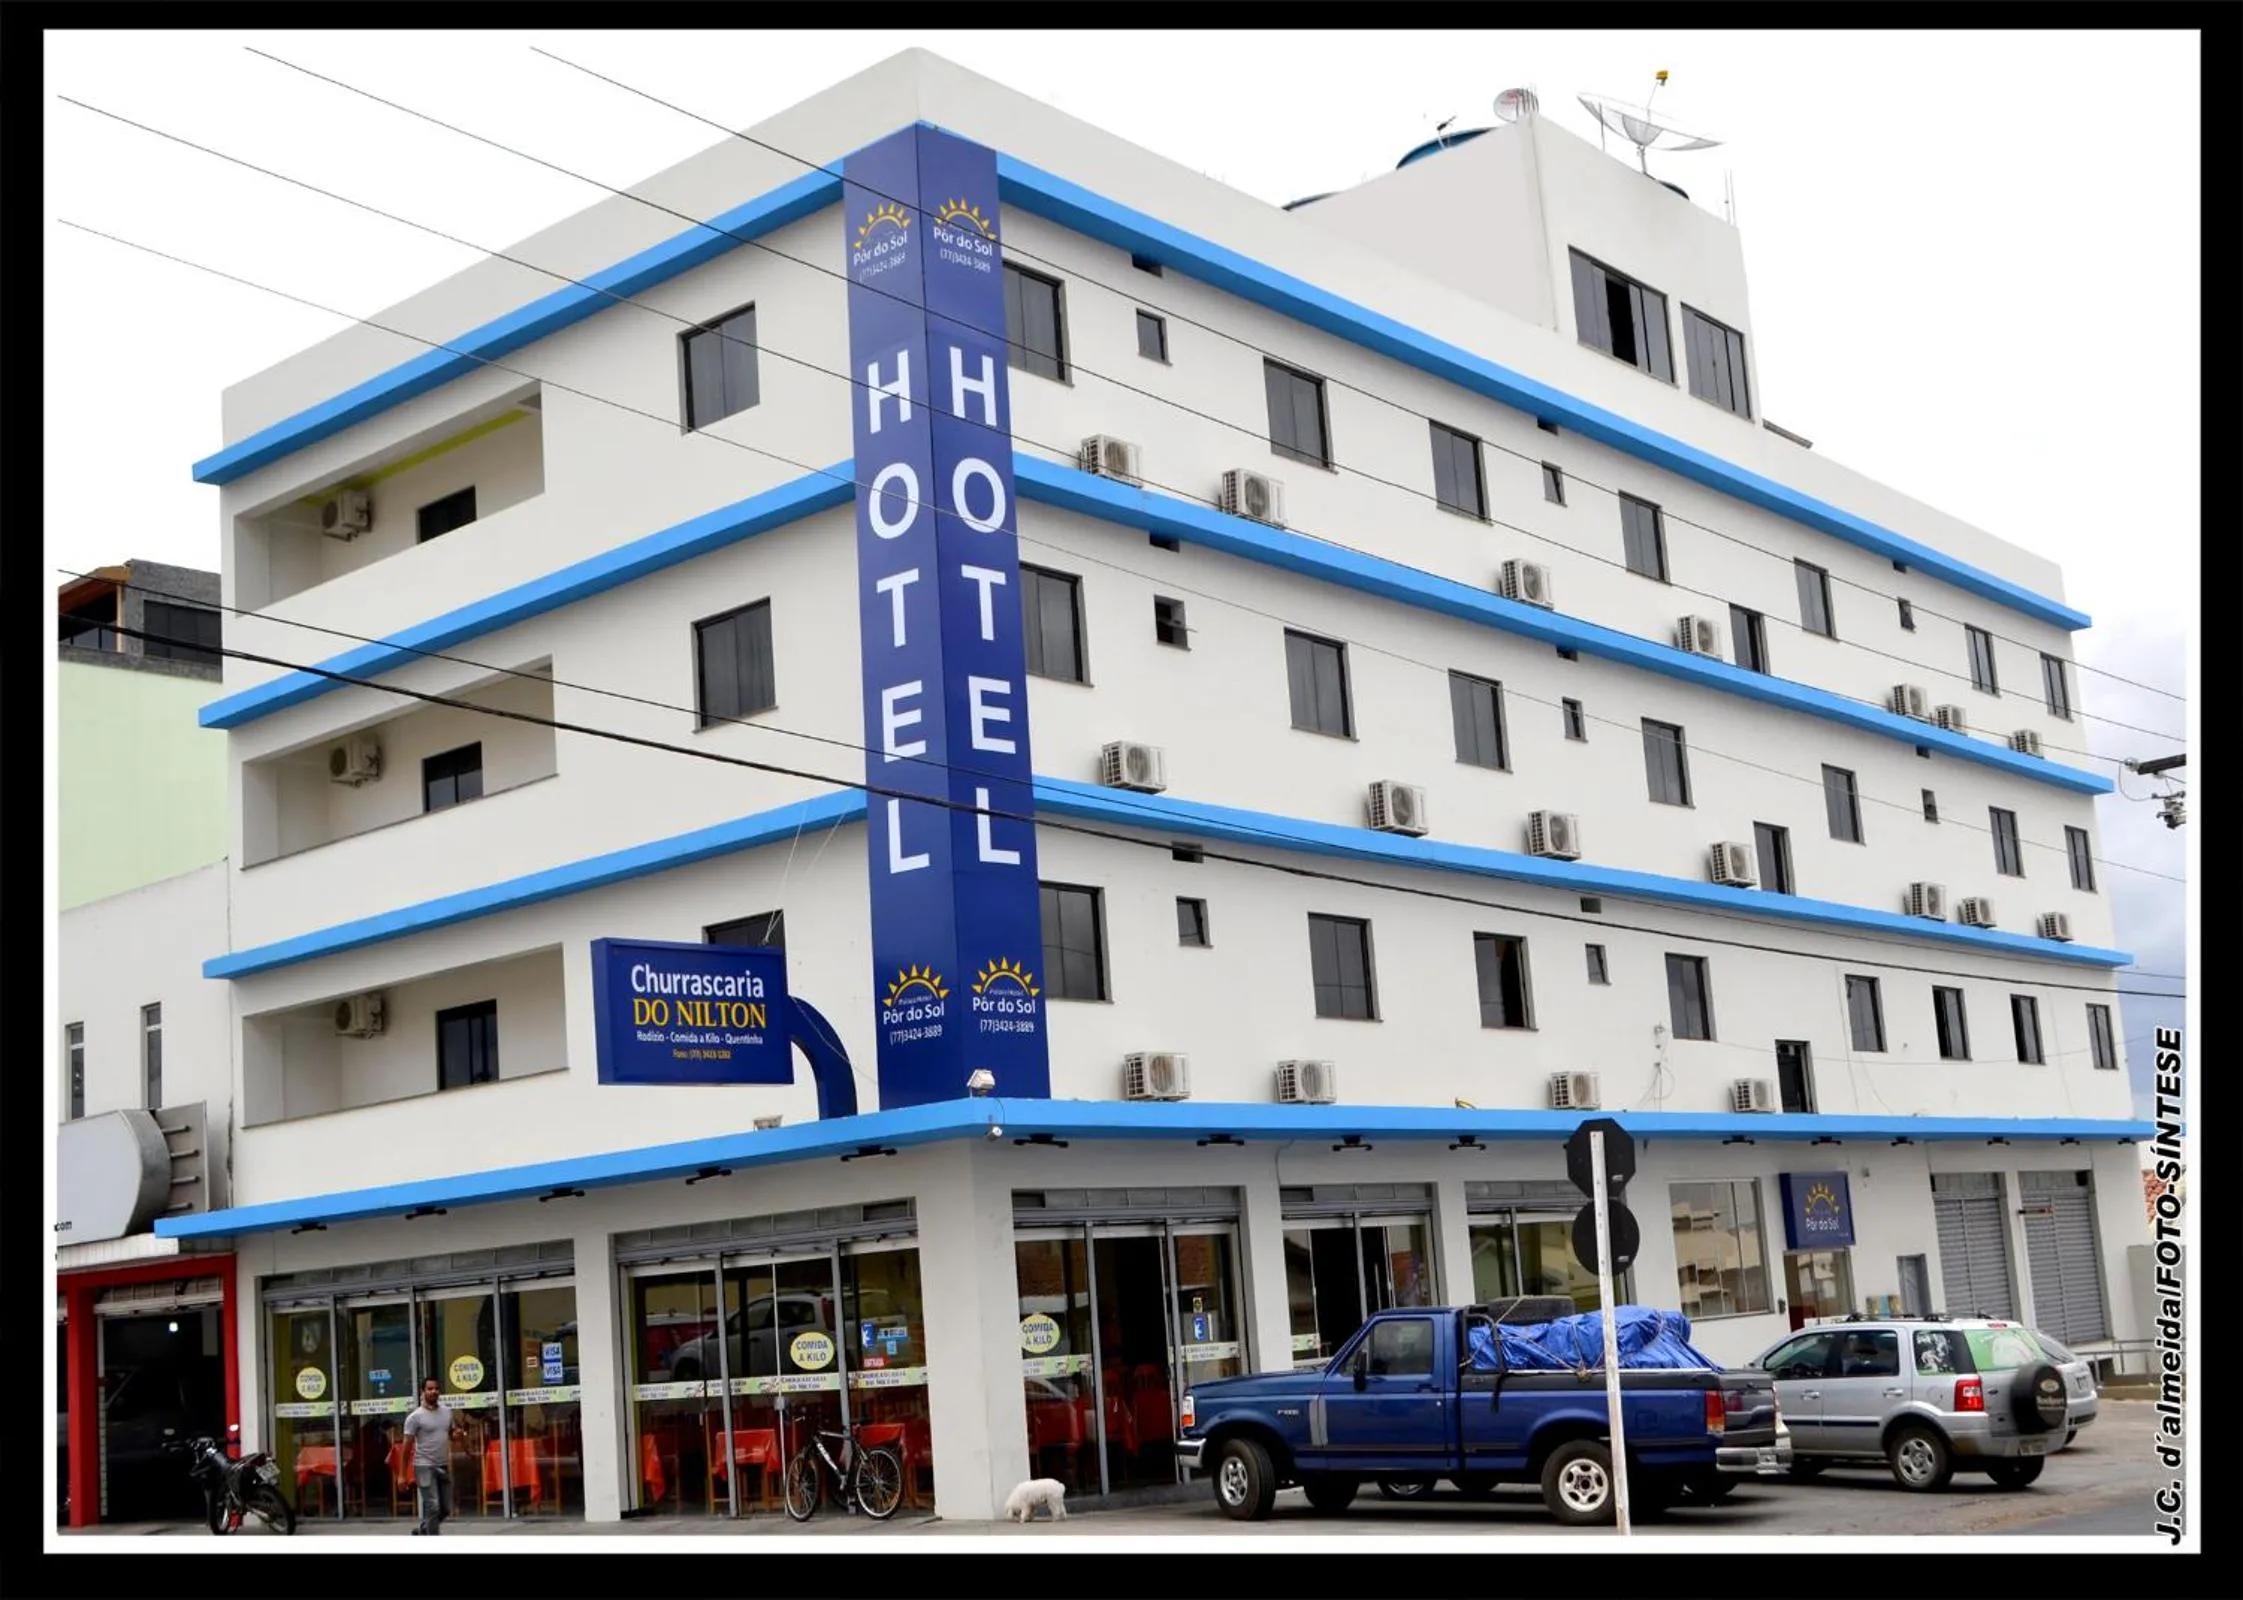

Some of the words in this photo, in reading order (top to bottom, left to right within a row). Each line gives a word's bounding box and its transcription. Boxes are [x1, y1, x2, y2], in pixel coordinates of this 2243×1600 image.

[854, 250, 871, 266] Pôr
[874, 243, 888, 257] do
[890, 231, 908, 250] Sol
[934, 226, 953, 243] Pôr
[956, 236, 972, 250] do
[974, 241, 992, 256] Sol
[868, 349, 930, 874] HOTEL
[950, 346, 1021, 865] HOTEL
[631, 964, 764, 998] Churrascaria
[634, 998, 670, 1026] DO
[677, 1001, 766, 1029] NILTON
[883, 1010, 903, 1025] Pôr
[906, 1006, 922, 1022] do
[925, 1002, 944, 1018] Sol
[972, 997, 994, 1012] Pôr
[997, 998, 1014, 1013] do
[1016, 999, 1036, 1014] Sol
[980, 1020, 1034, 1033] (77)3424-3889
[670, 1032, 698, 1044] Comida
[706, 1032, 720, 1044] Kilo
[725, 1033, 763, 1045] Quentinha
[796, 1340, 828, 1350] COMIDA
[1026, 1336, 1030, 1345] A
[1033, 1334, 1052, 1345] KILO
[799, 1354, 804, 1362] A
[807, 1353, 826, 1362] KILO
